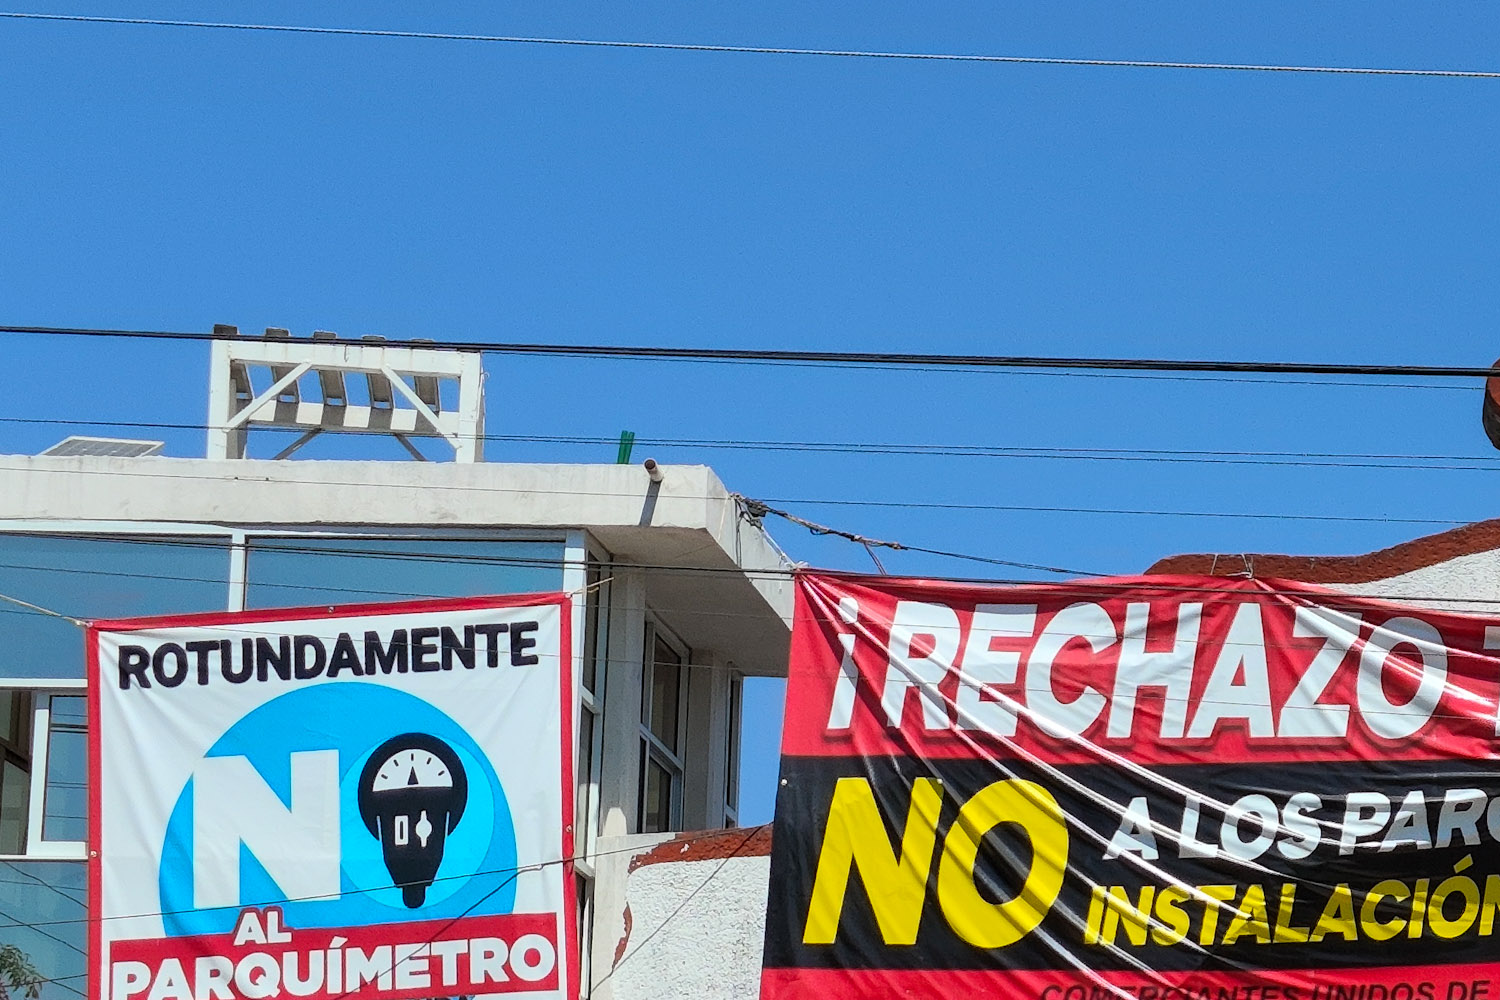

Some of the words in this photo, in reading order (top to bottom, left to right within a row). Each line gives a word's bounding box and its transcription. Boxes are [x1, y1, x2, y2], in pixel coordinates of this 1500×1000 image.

[119, 621, 540, 691] ROTUNDAMENTE
[1104, 796, 1159, 861] A
[1179, 793, 1321, 861] LOS
[803, 777, 1069, 948] NO
[234, 908, 291, 945] AL
